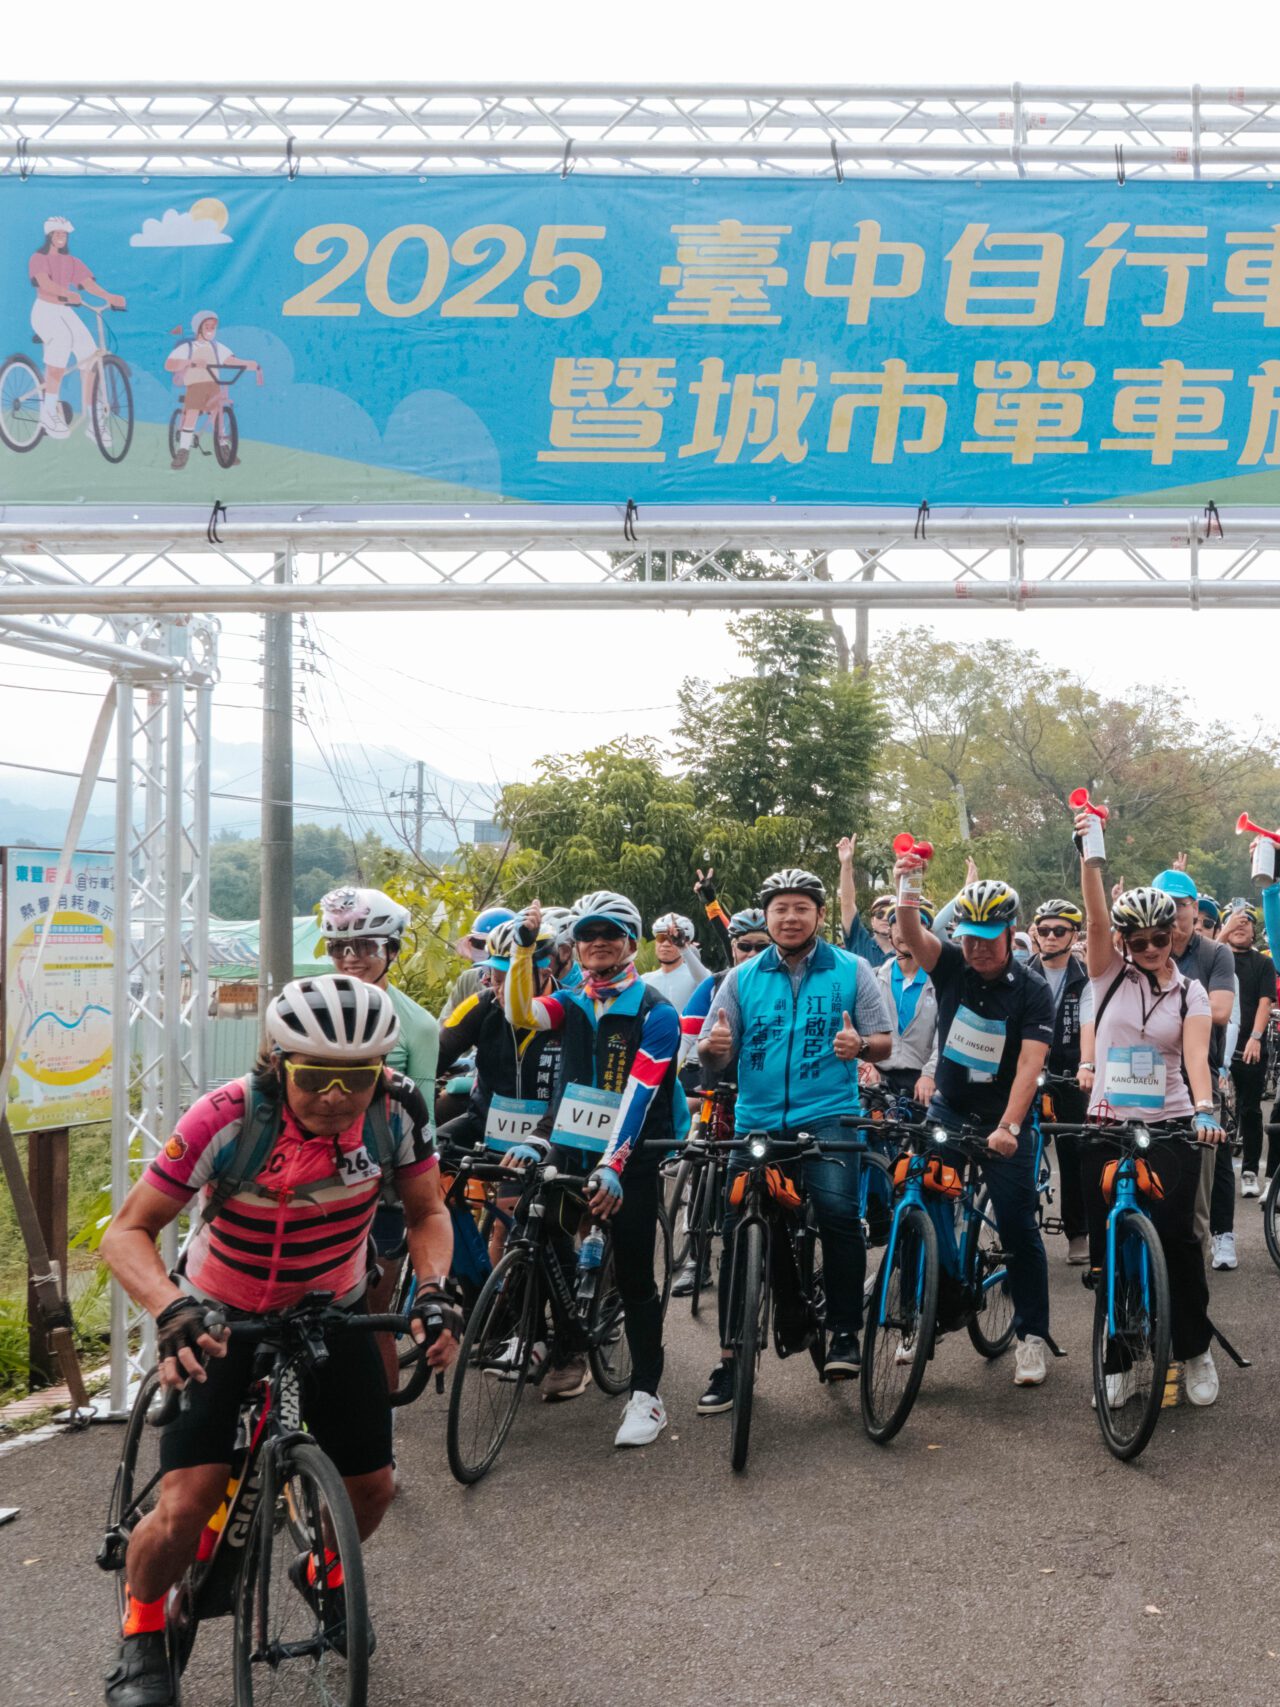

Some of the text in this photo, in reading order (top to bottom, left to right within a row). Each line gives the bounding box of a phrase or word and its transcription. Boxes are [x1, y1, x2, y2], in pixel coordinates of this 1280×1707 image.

[282, 222, 607, 319] 2025
[953, 1033, 996, 1054] LEE JINSEOK
[1111, 1076, 1132, 1085] KANG
[498, 1117, 532, 1135] VIP
[571, 1107, 611, 1128] VIP
